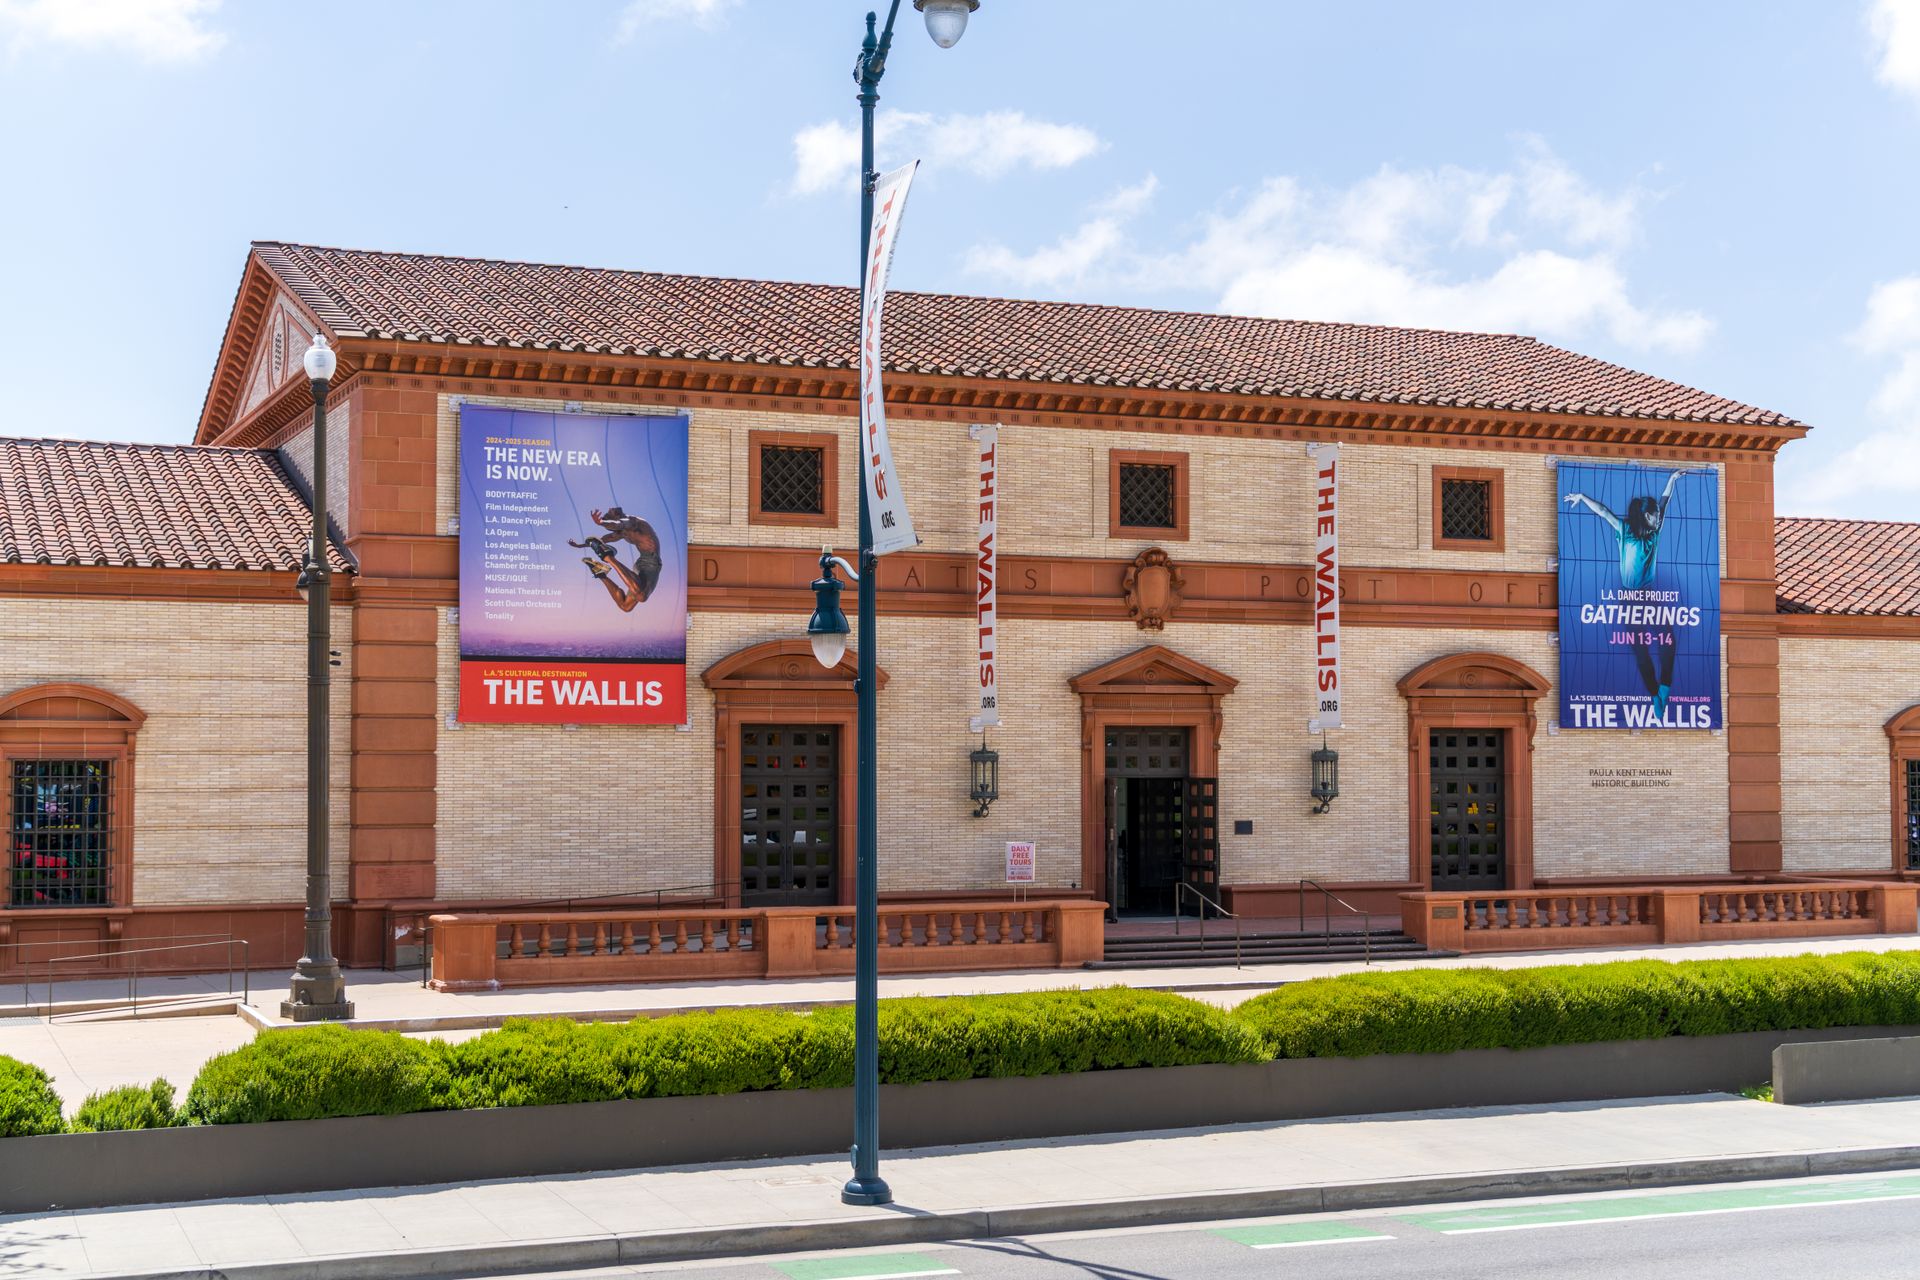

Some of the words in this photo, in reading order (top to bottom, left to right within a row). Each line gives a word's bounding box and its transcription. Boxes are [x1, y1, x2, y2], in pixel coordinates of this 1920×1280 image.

[484, 446, 518, 463] THE
[522, 448, 563, 465] NEW
[567, 450, 602, 466] ERA
[486, 464, 502, 480] IS
[506, 466, 552, 482] NOW.
[980, 442, 995, 525] THE
[485, 490, 538, 500] BODYTRAFFIC
[1318, 460, 1336, 538] THE
[485, 502, 502, 510] Film
[502, 504, 548, 513] Independent
[484, 516, 500, 524] L.A.
[501, 516, 524, 524] Dance
[525, 517, 552, 526] Project
[484, 528, 496, 536] LA
[496, 528, 519, 538] Opera
[484, 540, 498, 548] Los
[500, 541, 529, 550] Angeles
[530, 542, 552, 550] Ballet
[484, 552, 498, 560] Los
[500, 552, 529, 562] Angeles
[484, 561, 518, 570] Chamber
[519, 562, 555, 571] Orchestra
[484, 574, 528, 582] MUSE/IQUE
[484, 586, 516, 594] National
[518, 587, 546, 596] Theatre
[1601, 588, 1616, 601] L.A.
[1618, 589, 1644, 602] DANCE
[1646, 590, 1680, 602] PROJECT
[484, 599, 504, 607] Scott
[506, 600, 525, 608] Dunn
[526, 600, 562, 608] Orchestra
[977, 532, 994, 688] WALLIS
[1580, 604, 1701, 627] GATHERINGS
[485, 611, 514, 622] Tonality
[1316, 545, 1337, 692] WALLIS
[1609, 632, 1635, 646] JUN
[1638, 632, 1673, 646] 13-14
[505, 670, 540, 678] CULTURAL
[542, 670, 588, 678] DESTINATION
[483, 679, 544, 705] THE
[551, 680, 664, 707] WALLIS
[1319, 700, 1338, 712] .ORG
[1570, 704, 1618, 728] THE
[1622, 704, 1712, 728] WALLIS
[1589, 768, 1614, 776] PAULA
[1616, 768, 1637, 776] KENT
[1638, 768, 1672, 776] MEEHAN
[1591, 779, 1630, 788] HISTORIC
[1631, 779, 1670, 788] BUILDING
